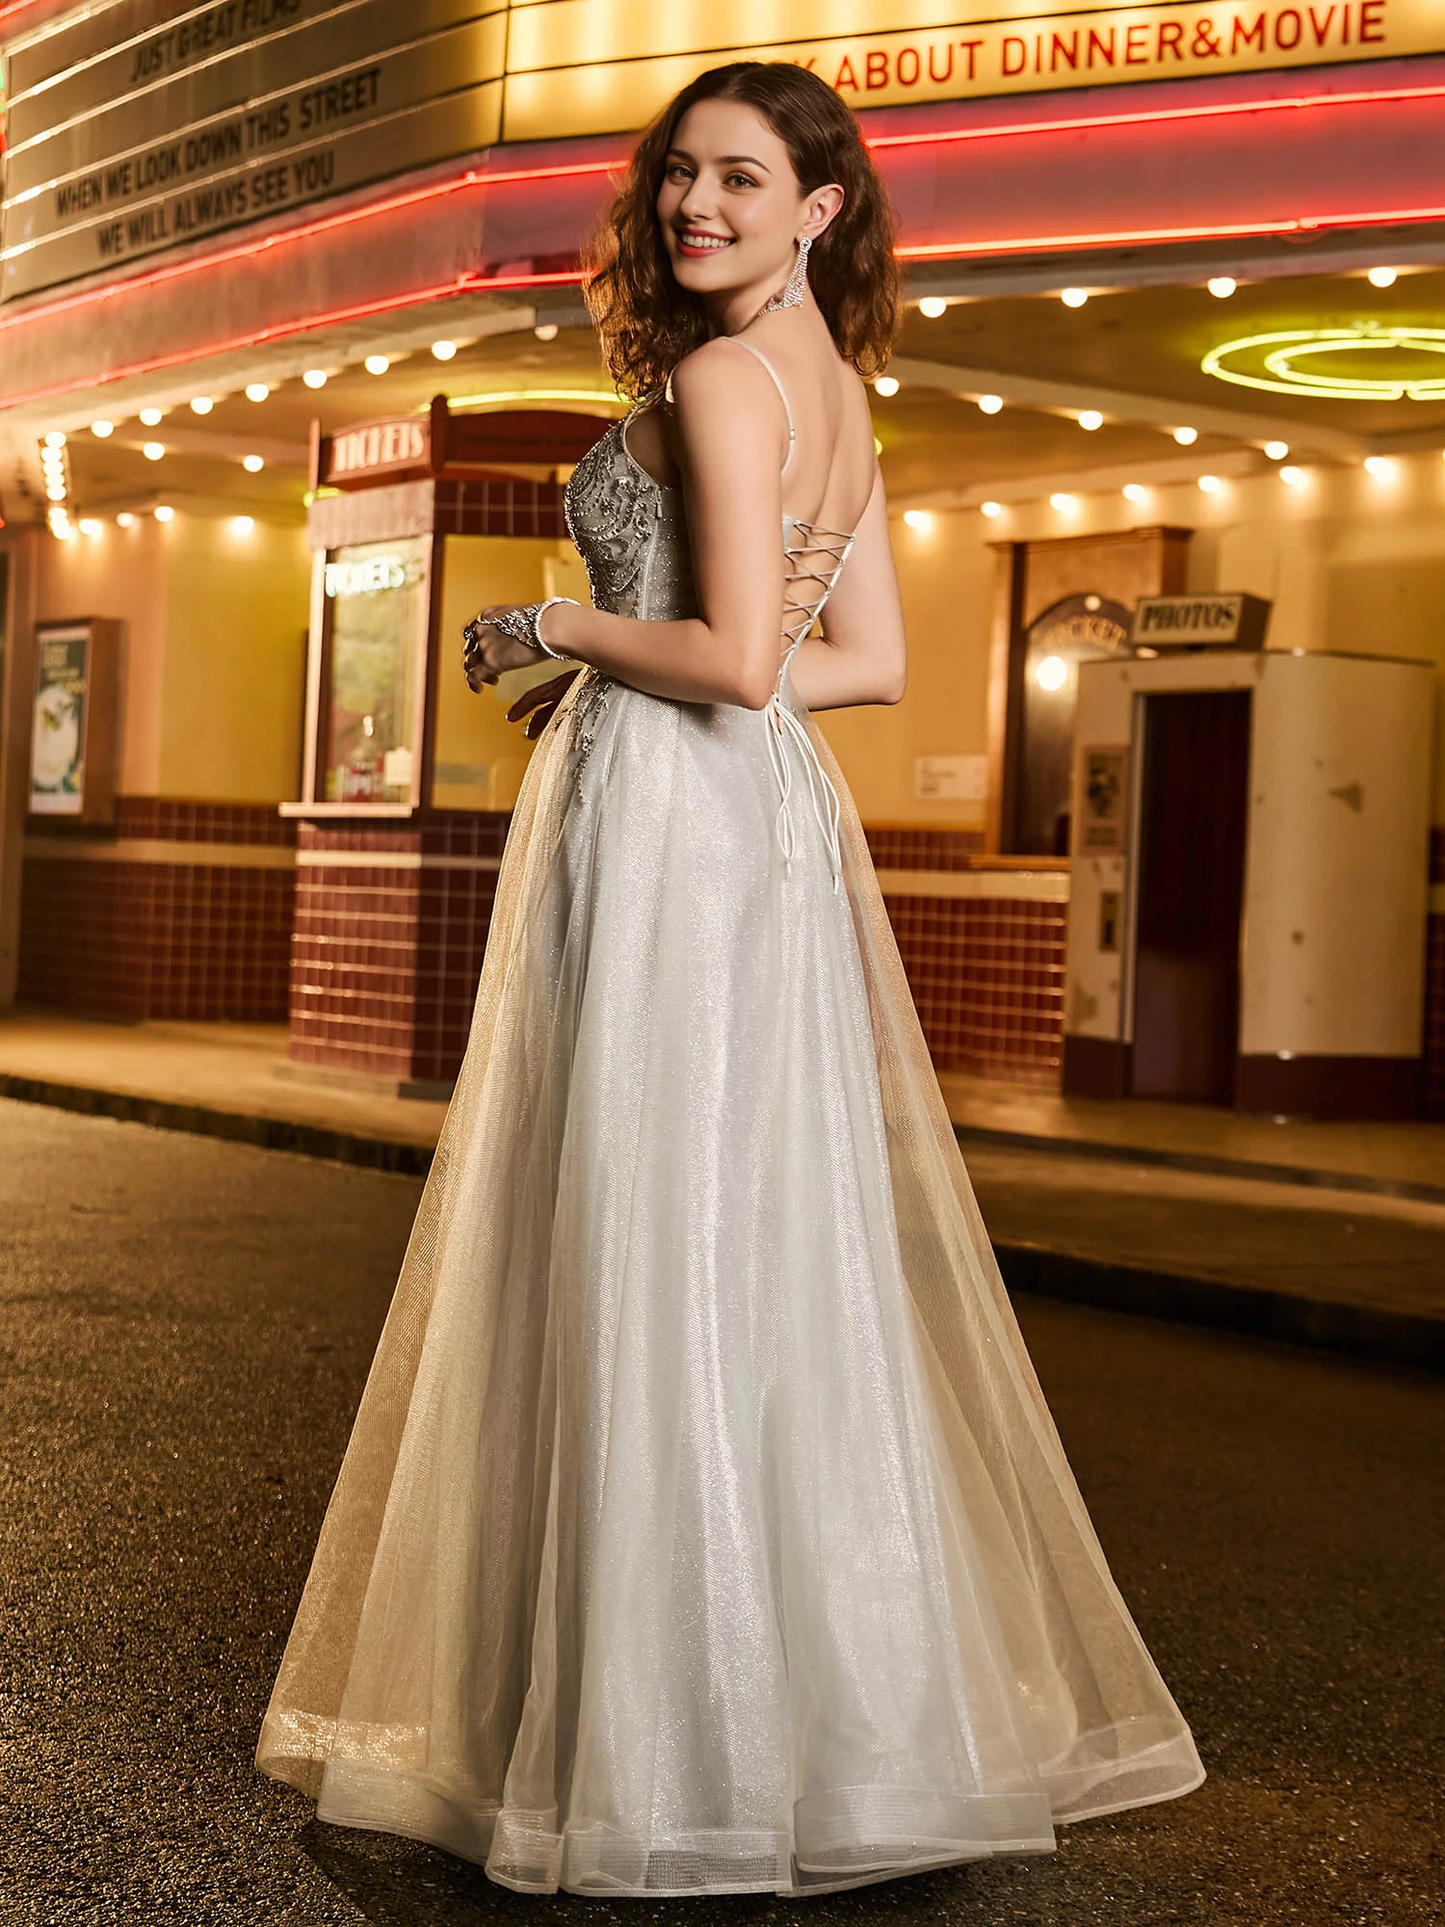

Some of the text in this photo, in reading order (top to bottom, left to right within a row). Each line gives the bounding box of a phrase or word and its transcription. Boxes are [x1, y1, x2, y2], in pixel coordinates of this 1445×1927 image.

[131, 32, 174, 82] JUST
[834, 40, 984, 92] ABOUT
[56, 67, 382, 218] WHEN WE LOOK DOWN THIS STREET
[98, 149, 335, 257] WE WILL ALWAYS SEE YOU
[1141, 601, 1236, 633] PHOTOS
